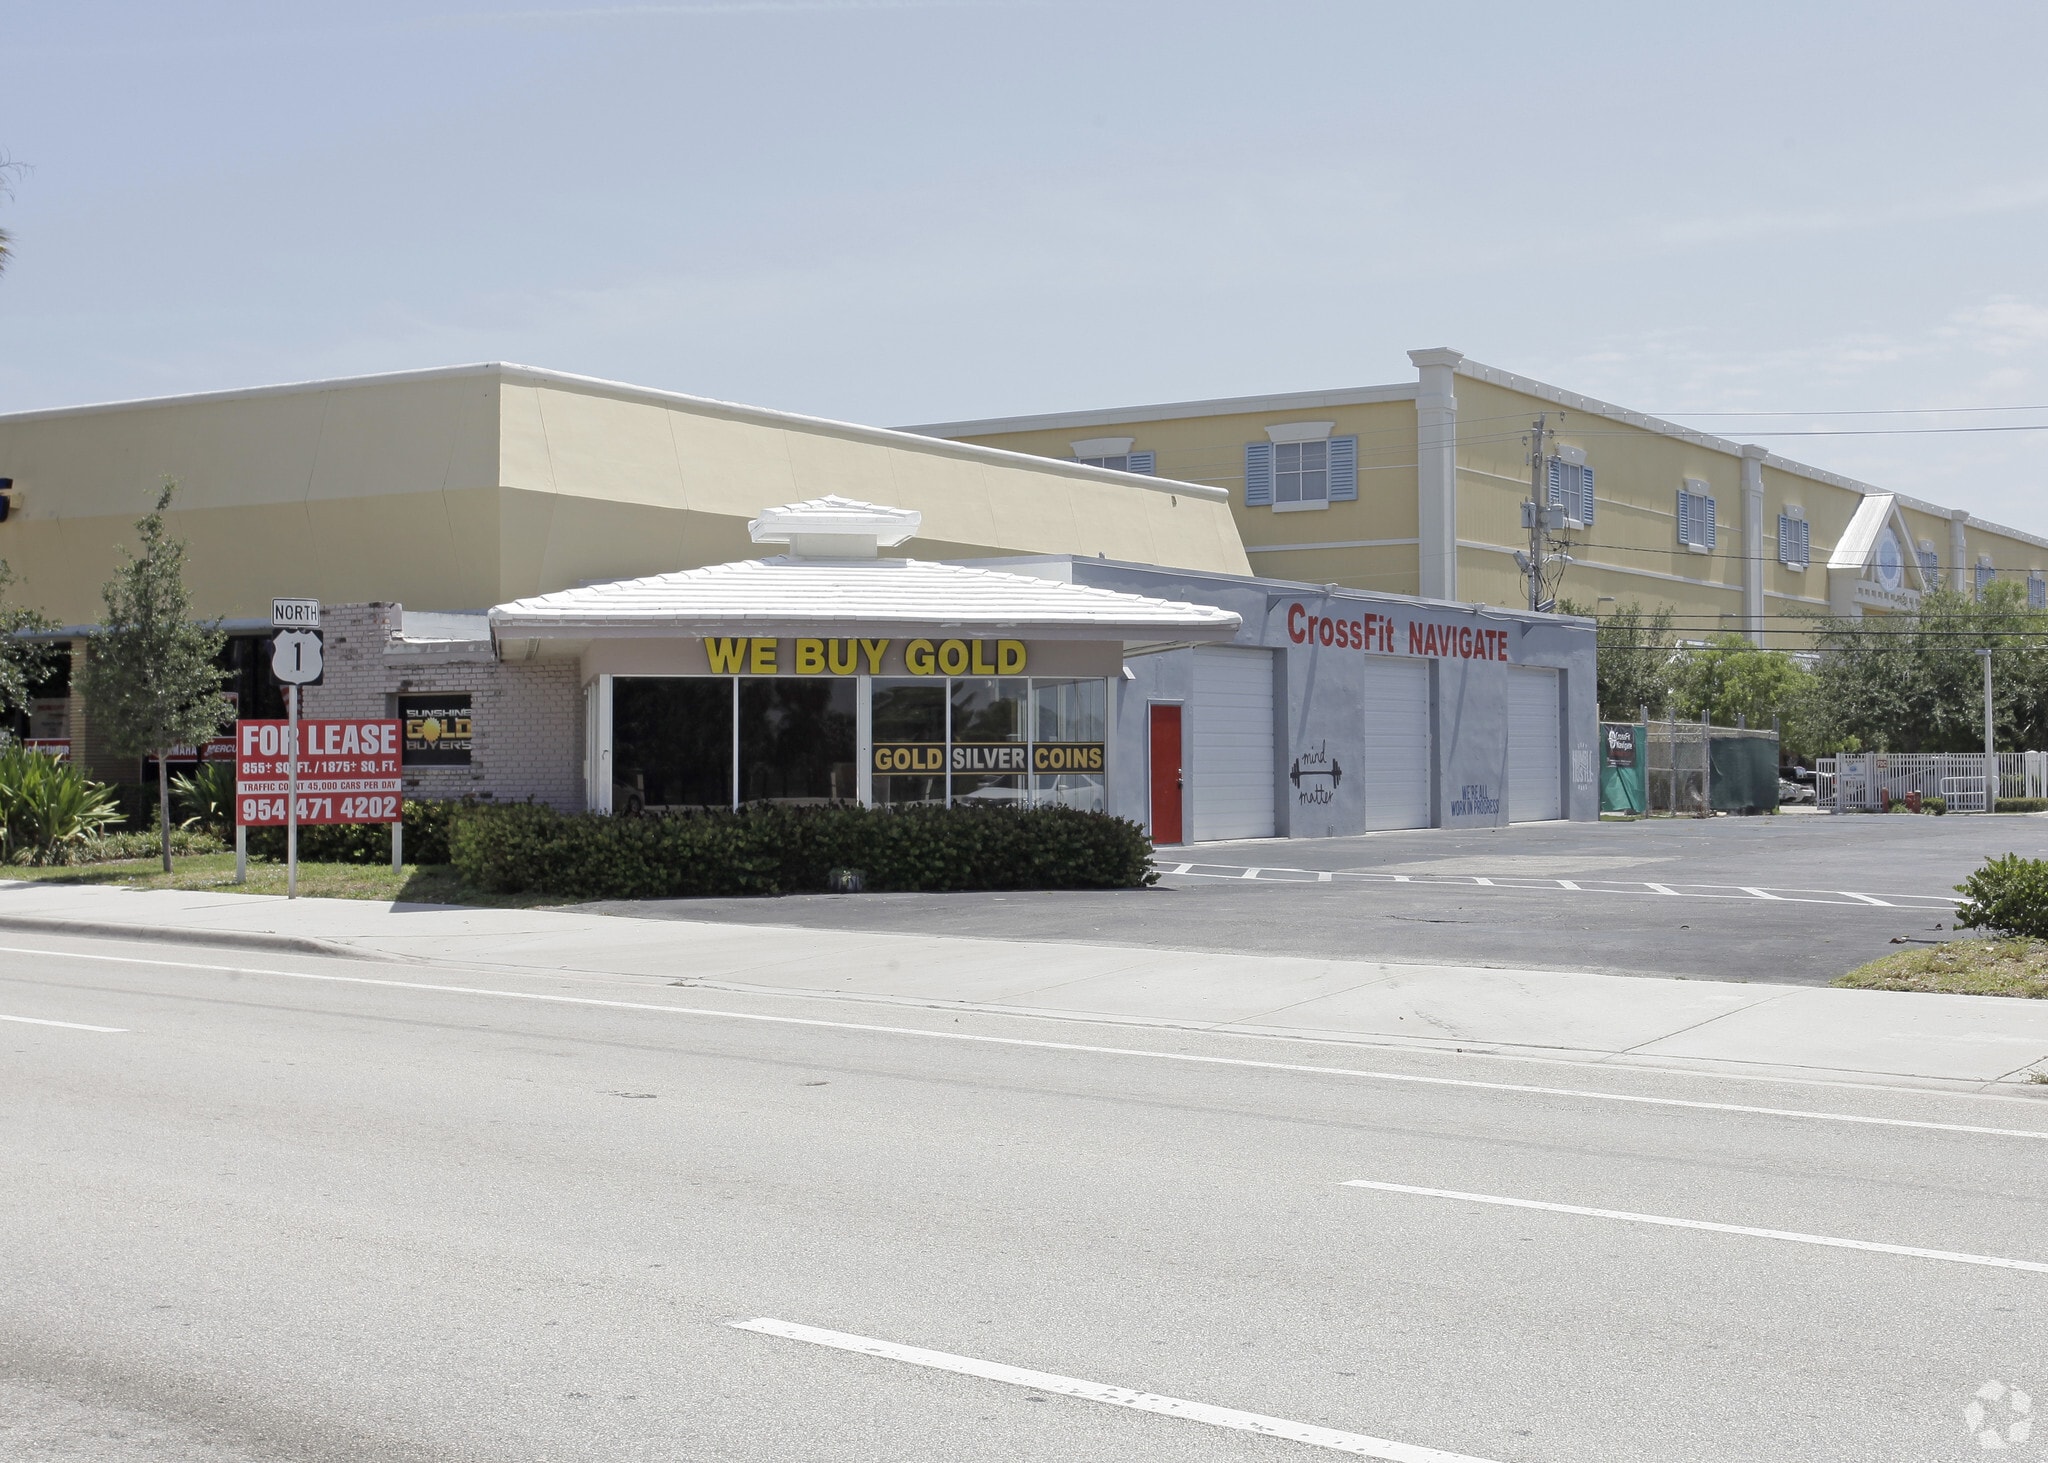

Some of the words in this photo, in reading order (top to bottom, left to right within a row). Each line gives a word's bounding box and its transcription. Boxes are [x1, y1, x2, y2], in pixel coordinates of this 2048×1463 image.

[275, 604, 317, 620] NORTH
[1287, 602, 1394, 653] CrossFit
[1408, 620, 1508, 662] NAVIGATE
[294, 642, 301, 671] 1
[704, 637, 778, 674] WE
[795, 638, 890, 675] BUY
[905, 638, 1027, 675] GOLD
[406, 708, 472, 717] SUNSHINE
[243, 725, 299, 756] FOR
[308, 724, 397, 755] LEASE
[406, 740, 472, 750] BUYERS
[875, 747, 943, 770] GOLD
[952, 747, 1025, 770] SILVER
[1034, 747, 1102, 769] COINS
[1302, 739, 1327, 765] mind
[361, 761, 379, 774] SQ.
[382, 760, 397, 772] FT.
[244, 783, 275, 791] TRAFFIC
[278, 782, 304, 791] CONT
[307, 782, 338, 791] 45,000
[340, 781, 361, 790] CARS
[363, 781, 379, 789] PER
[381, 780, 396, 788] DAY
[1299, 783, 1334, 806] matter
[243, 799, 286, 821] 954
[296, 798, 332, 819] 471
[340, 796, 397, 818] 4202
